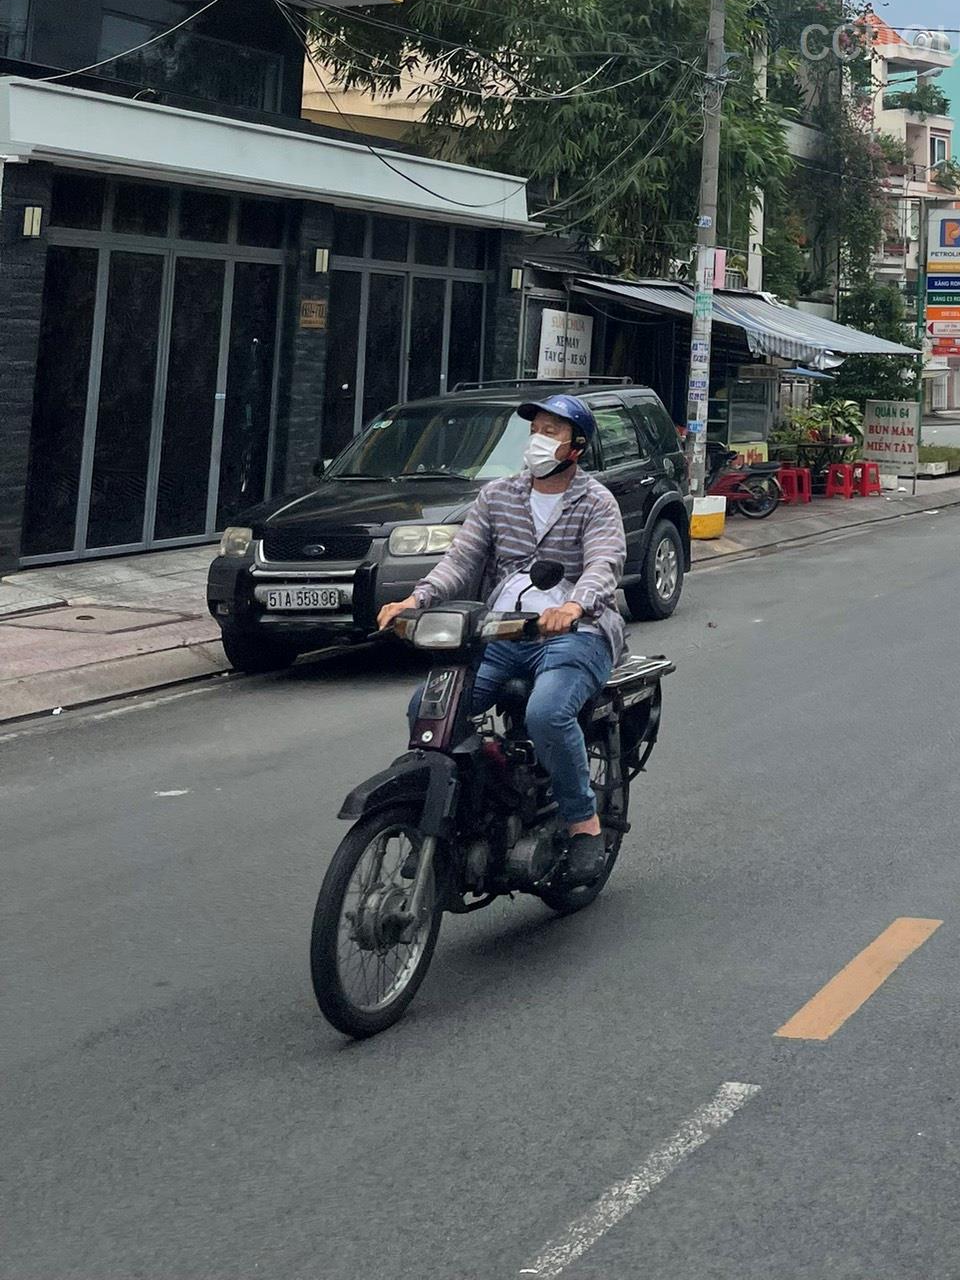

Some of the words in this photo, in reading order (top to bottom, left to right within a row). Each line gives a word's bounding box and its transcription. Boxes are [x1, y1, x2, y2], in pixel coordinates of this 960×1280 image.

[556, 335, 564, 347] XE
[544, 351, 557, 362] TAY
[570, 353, 578, 365] XE
[899, 408, 909, 418] 64
[269, 591, 292, 607] 51A
